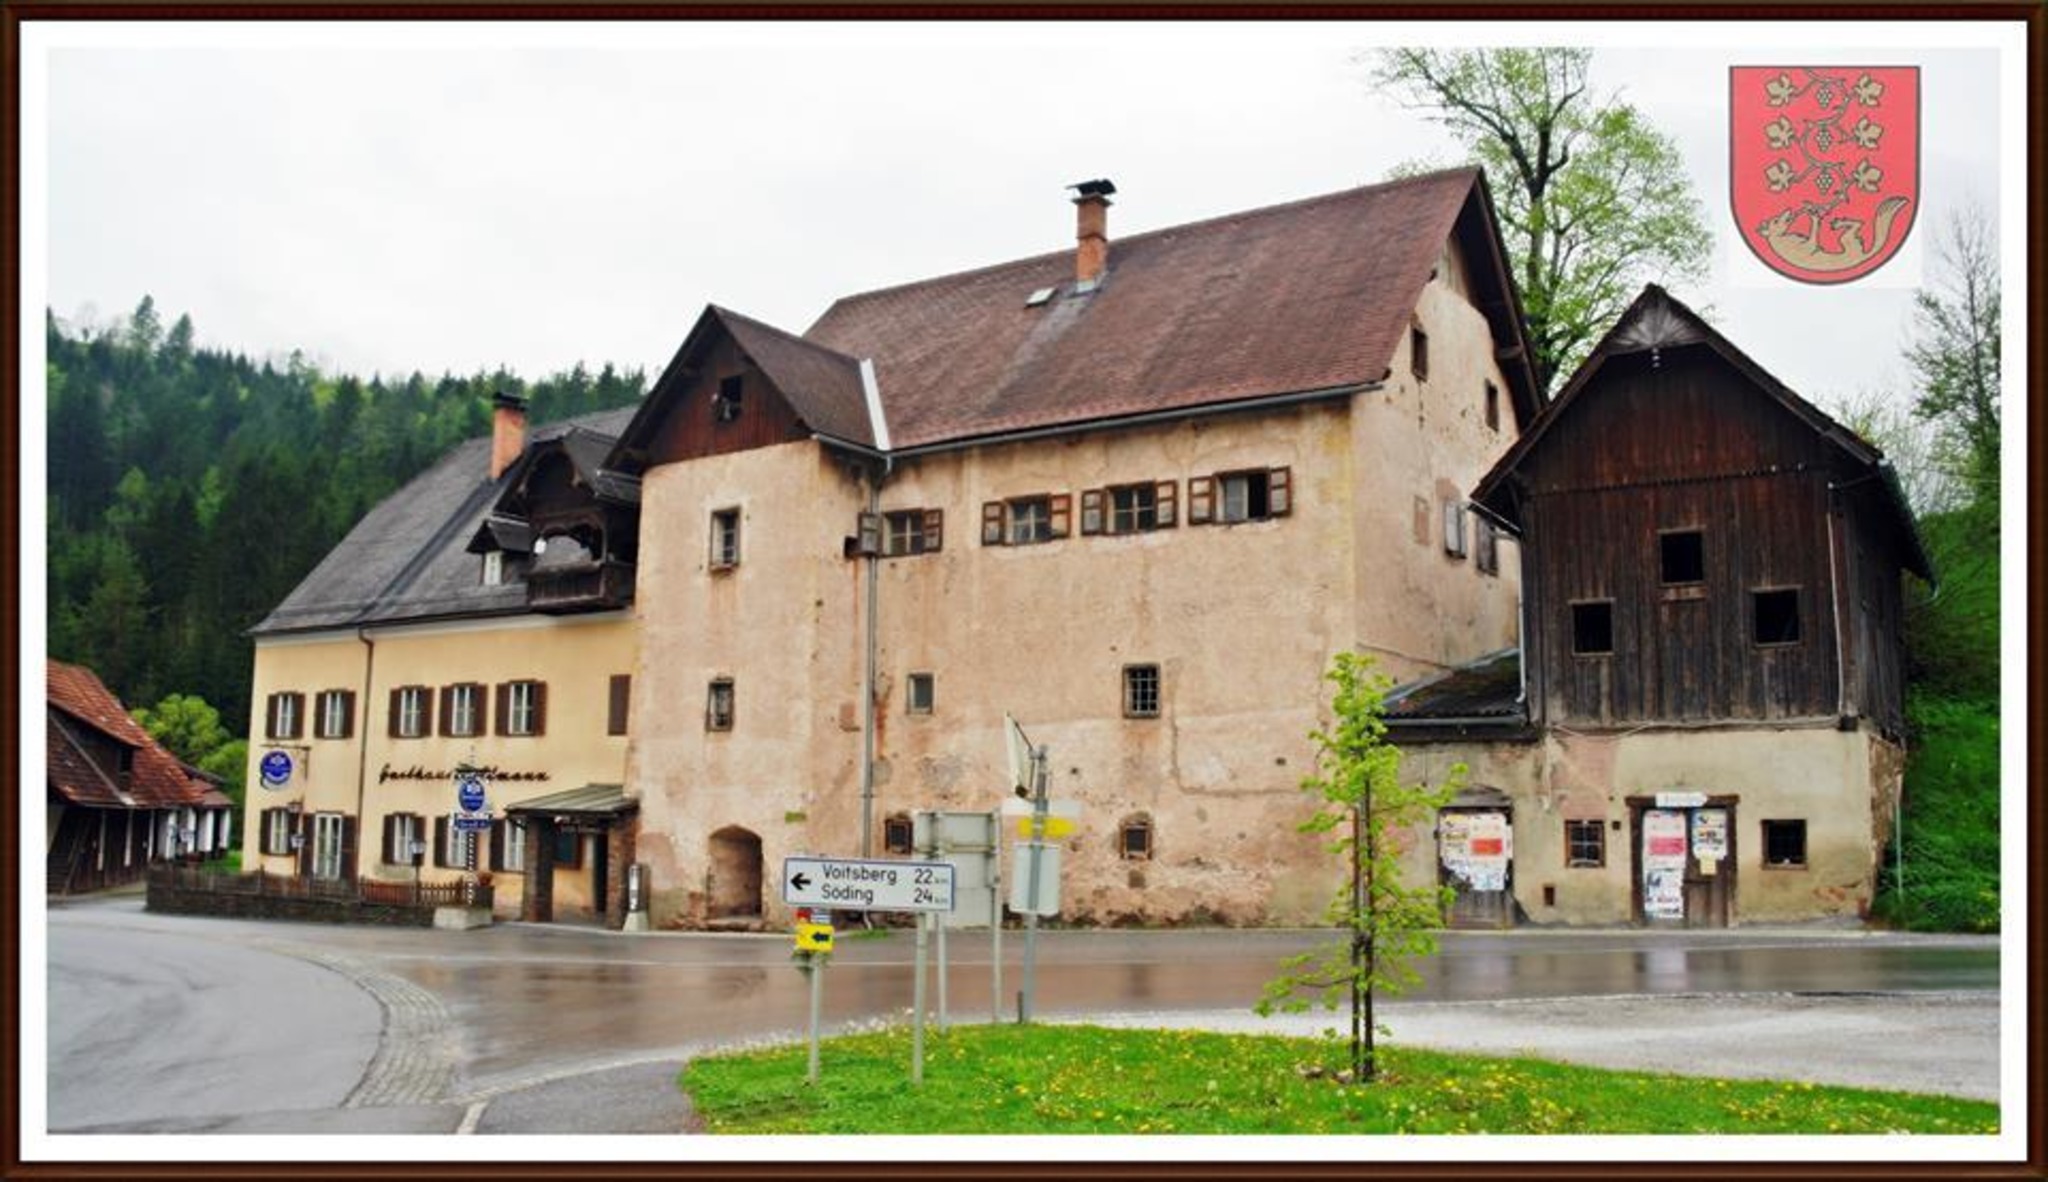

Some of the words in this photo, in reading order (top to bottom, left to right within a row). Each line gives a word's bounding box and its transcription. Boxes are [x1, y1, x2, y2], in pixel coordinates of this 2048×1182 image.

[822, 863, 897, 886] Voitsberg
[914, 867, 934, 884] 22
[913, 886, 934, 904] 24
